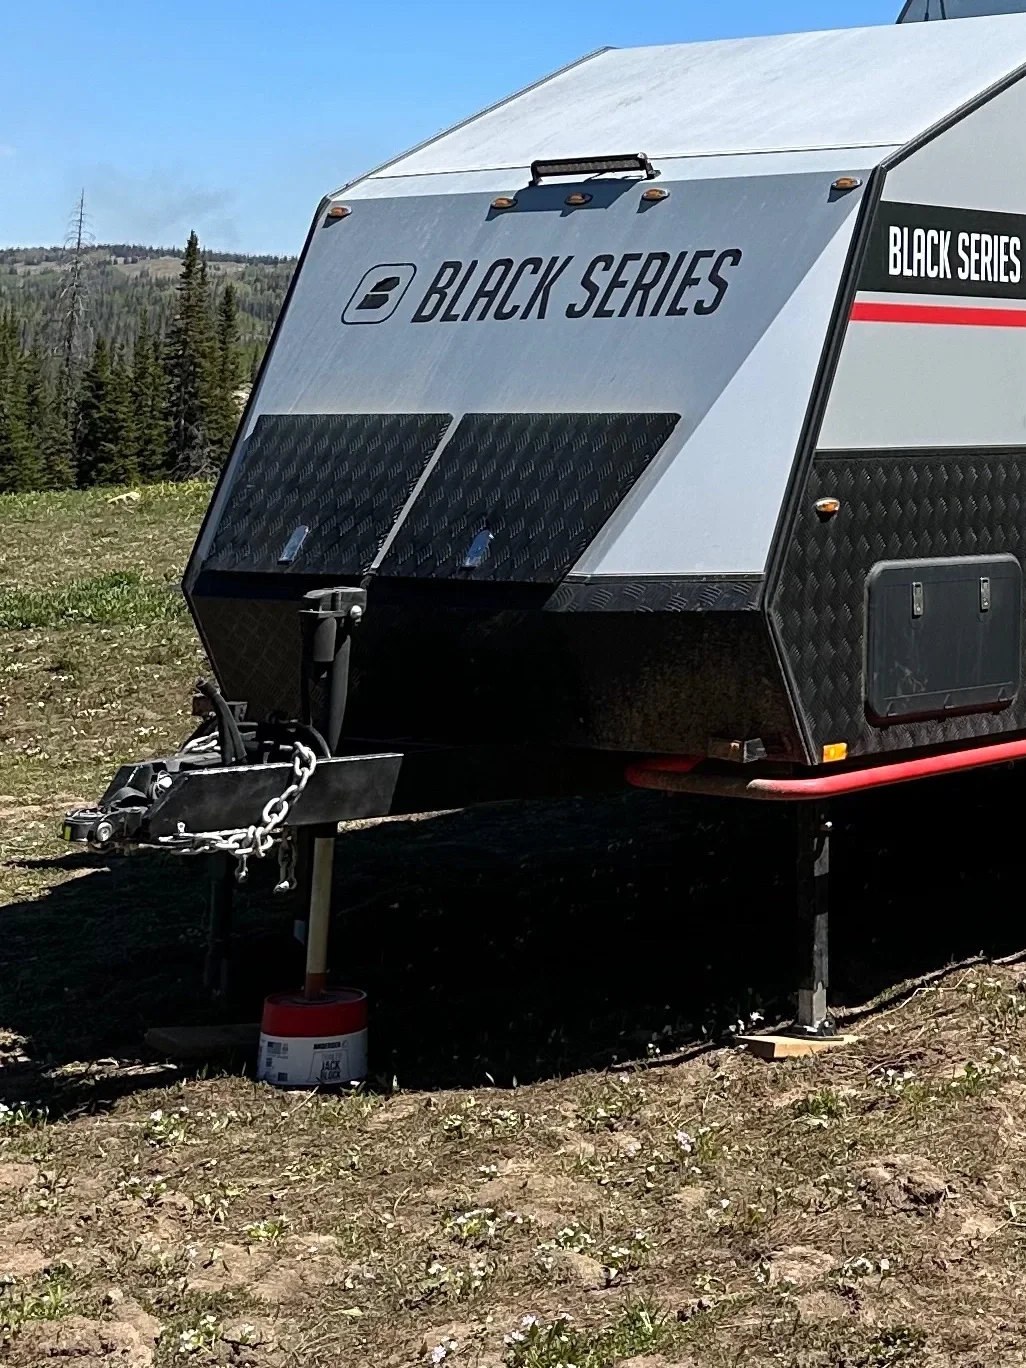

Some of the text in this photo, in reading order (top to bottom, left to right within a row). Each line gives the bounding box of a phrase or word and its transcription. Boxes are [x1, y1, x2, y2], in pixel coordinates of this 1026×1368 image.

[889, 226, 1021, 283] BLACK SERIES
[411, 249, 742, 323] BLACK SERIES
[321, 1060, 341, 1071] JACK
